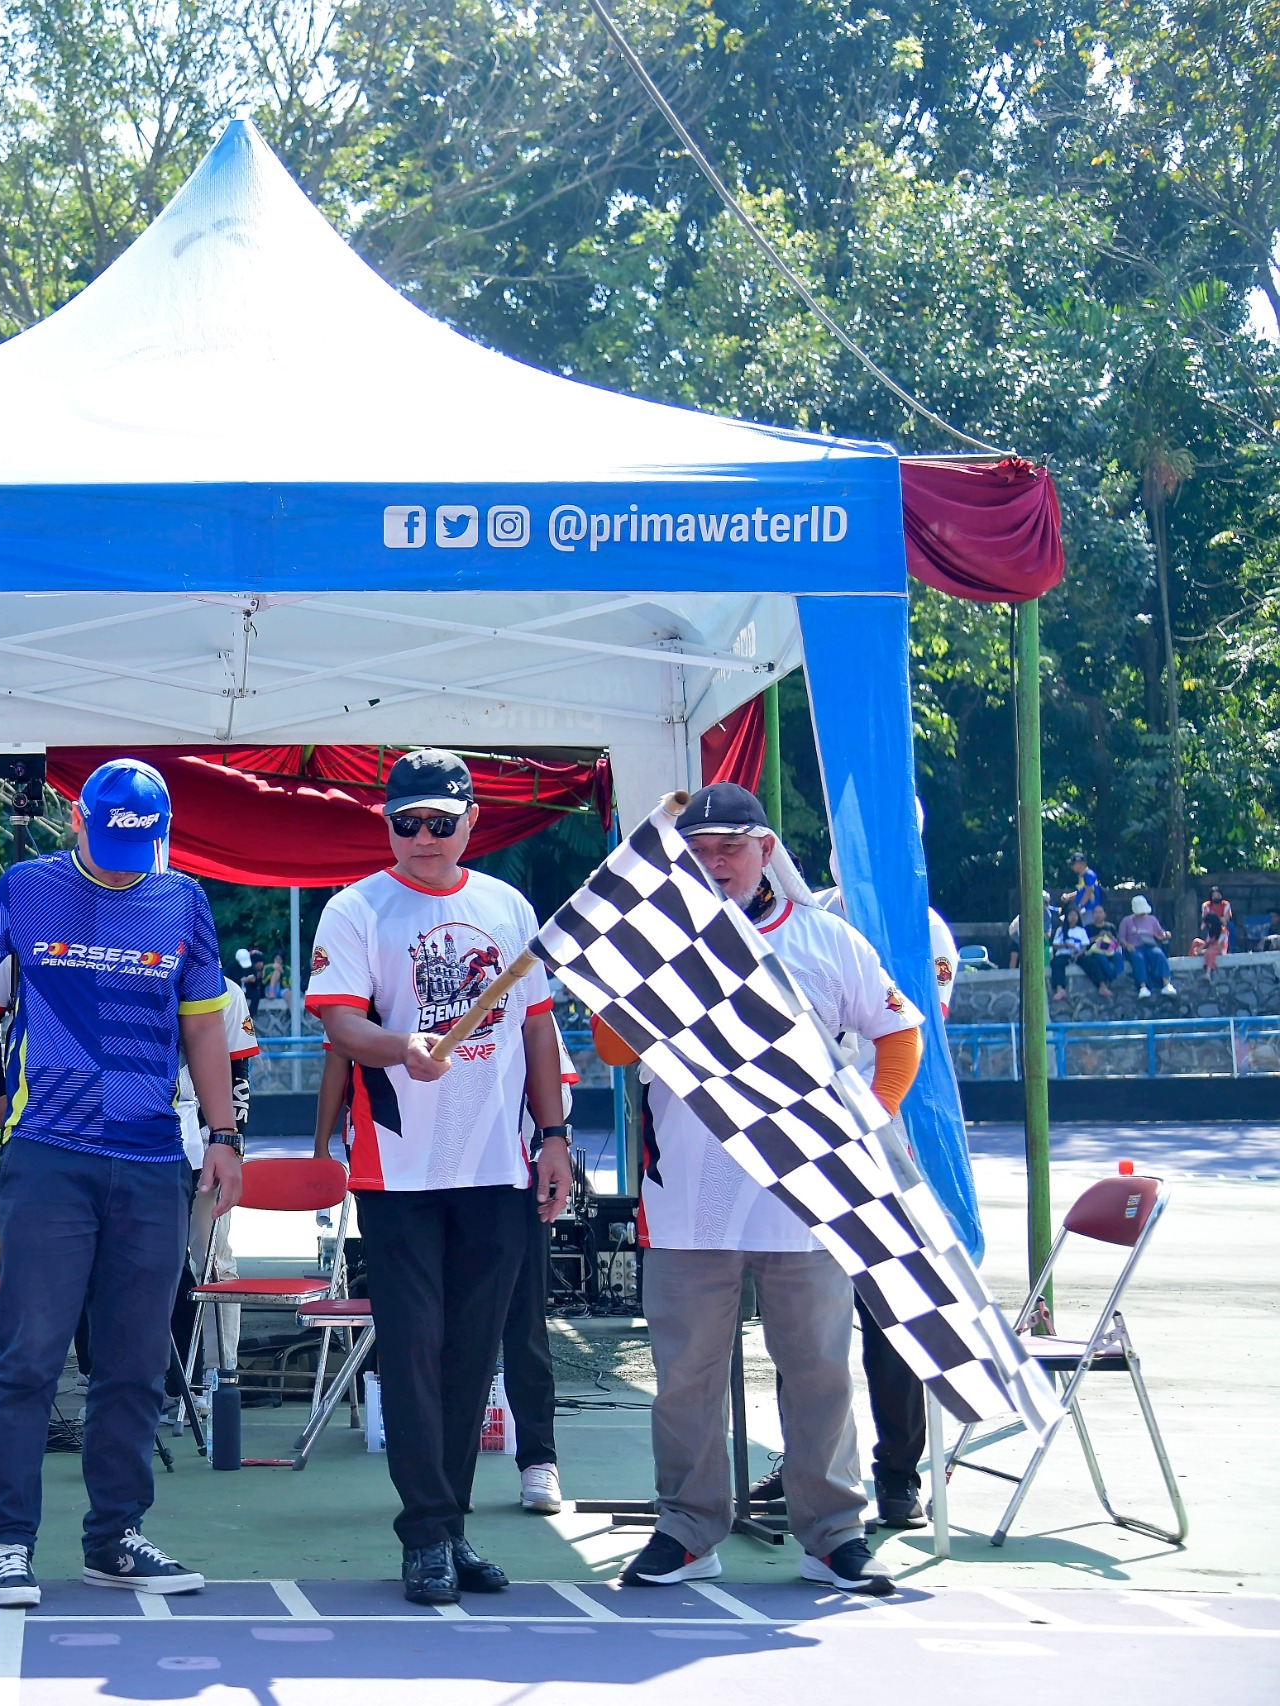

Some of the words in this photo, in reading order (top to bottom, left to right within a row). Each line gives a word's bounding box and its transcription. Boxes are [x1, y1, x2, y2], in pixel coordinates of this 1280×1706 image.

[548, 504, 848, 552] @primawaterID
[106, 812, 160, 829] KOREA
[41, 958, 117, 972] PENGPROV
[118, 966, 170, 979] JATENG
[419, 990, 507, 1031] SEMAG
